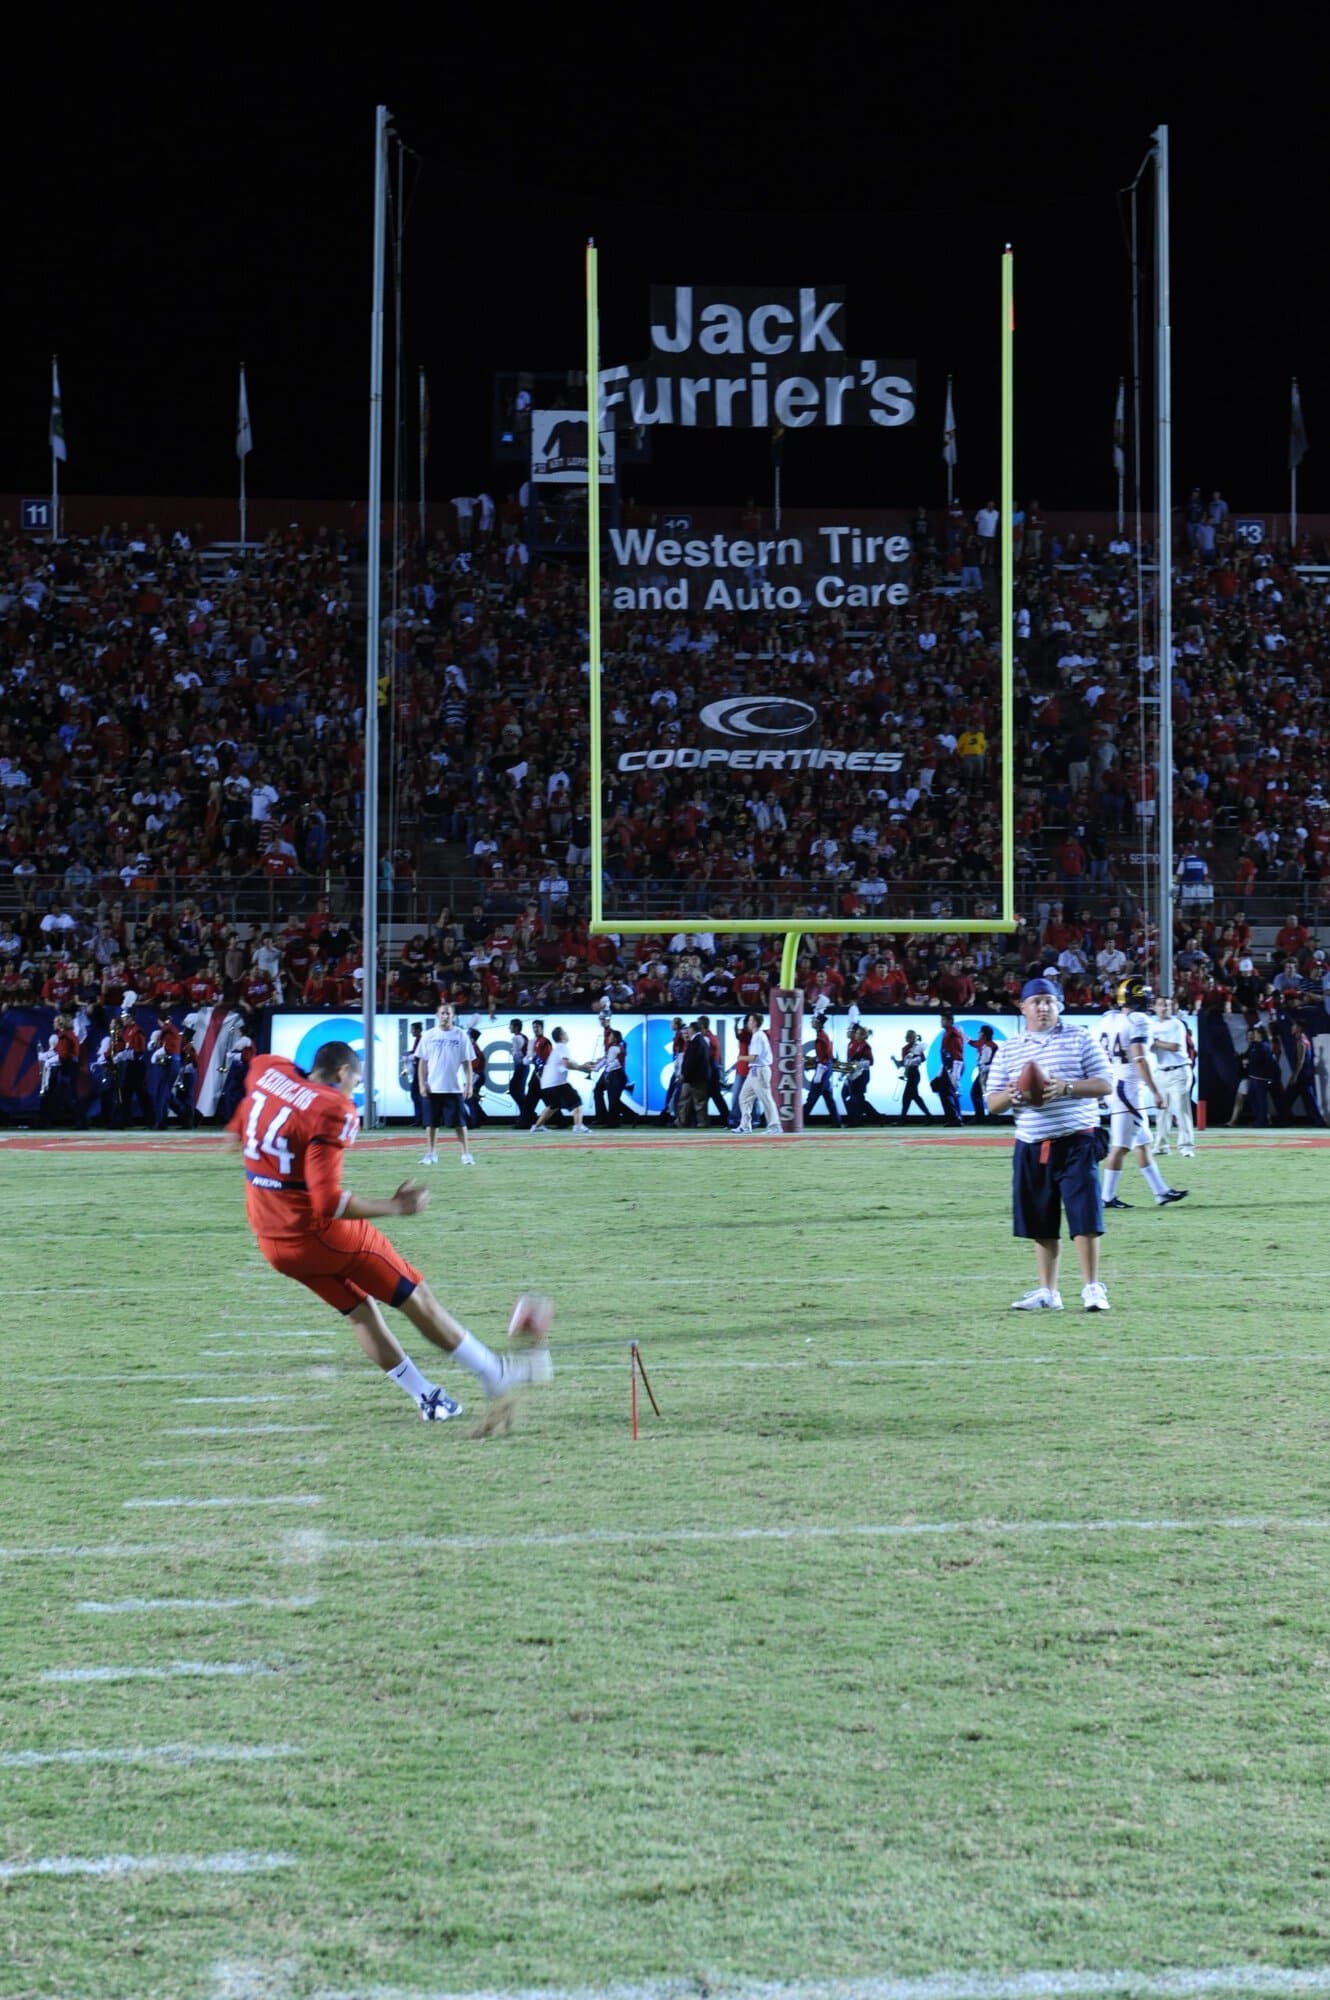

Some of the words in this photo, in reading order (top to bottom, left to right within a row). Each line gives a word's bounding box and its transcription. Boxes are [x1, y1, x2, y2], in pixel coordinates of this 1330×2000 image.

[650, 285, 845, 355] Jack
[596, 359, 916, 429] Furrier's
[26, 504, 47, 525] 11
[608, 528, 804, 568] Western
[818, 526, 911, 564] Tire
[612, 578, 689, 611] and
[703, 578, 801, 612] Auto
[815, 575, 910, 609] Care
[776, 997, 800, 1121] WILDCATS
[243, 1090, 296, 1175] 14
